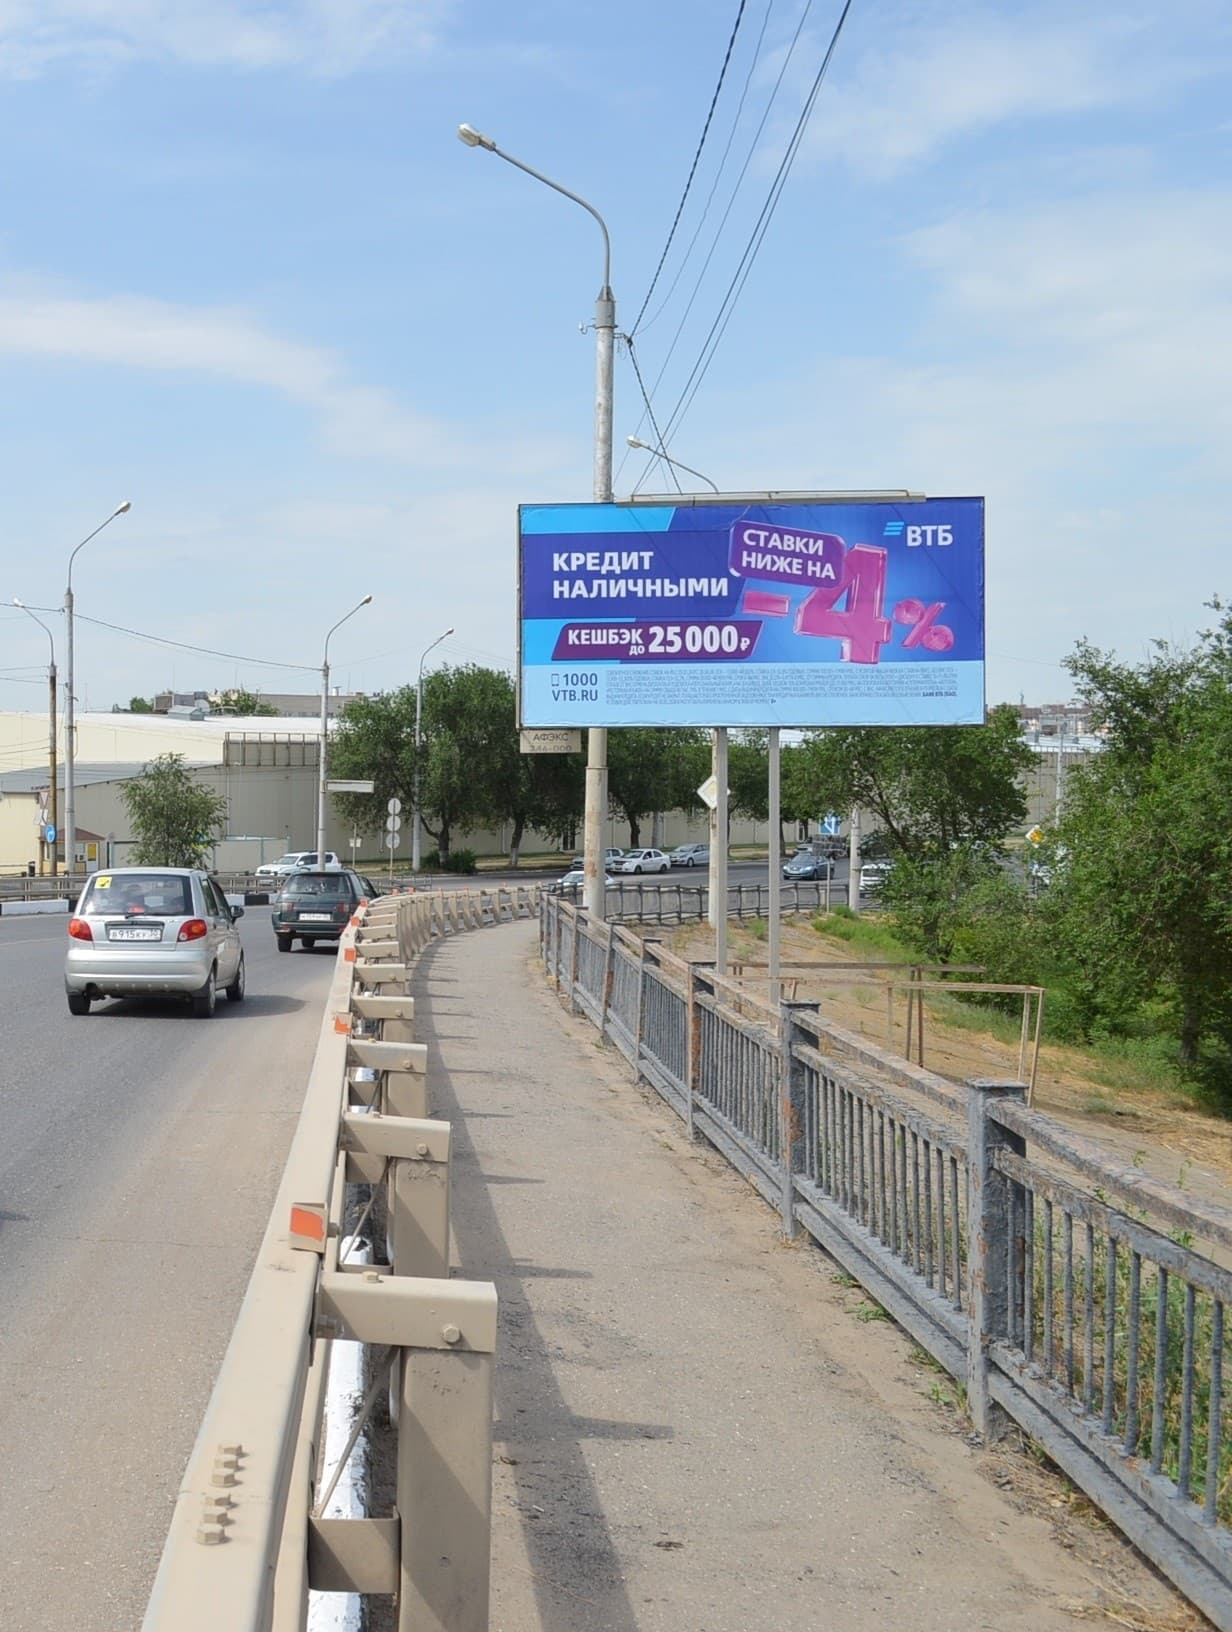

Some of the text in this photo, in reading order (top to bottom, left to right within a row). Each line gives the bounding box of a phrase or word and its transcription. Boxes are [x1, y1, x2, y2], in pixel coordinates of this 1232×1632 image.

[742, 528, 824, 556] СТАВКИ
[906, 524, 954, 547] ВТБ
[552, 551, 655, 575] КРЕДИТ
[741, 550, 836, 580] НИЖЕ НА
[552, 577, 729, 599] НАЛИЧНЫМИ
[567, 628, 643, 645] КЕШБЭК
[562, 672, 599, 687] 1000
[551, 689, 599, 702] VTB.RU
